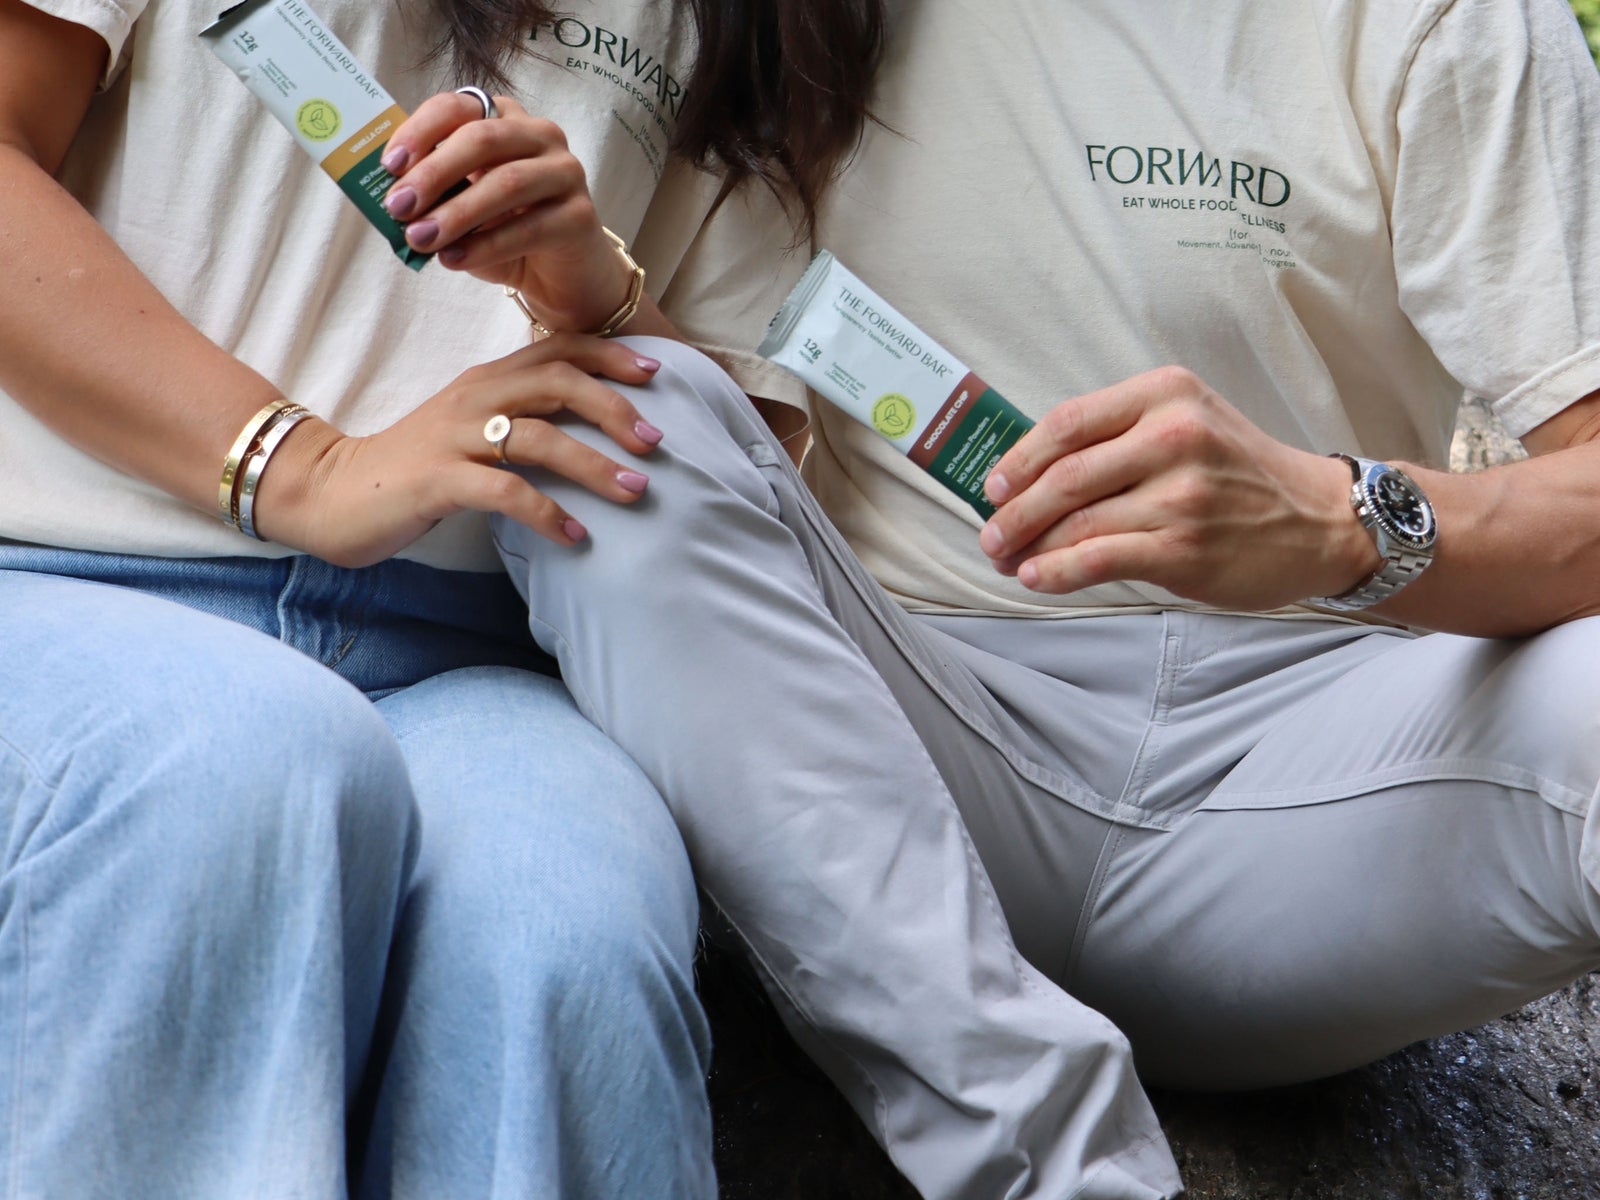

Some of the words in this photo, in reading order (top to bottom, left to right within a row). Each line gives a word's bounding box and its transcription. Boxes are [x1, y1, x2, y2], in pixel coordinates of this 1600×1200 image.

[239, 31, 259, 52] 12g
[304, 20, 358, 74] FORWARD
[322, 56, 338, 73] Better
[566, 57, 590, 71] EAT
[592, 64, 632, 92] WHOLE
[631, 88, 654, 113] FOOD
[359, 175, 371, 186] NO
[370, 187, 381, 197] NO
[1123, 197, 1144, 208] EAT
[1148, 198, 1195, 210] WHOLE
[1240, 213, 1285, 233] ELLNESS
[840, 287, 864, 312] THE
[862, 306, 922, 358] FORWARD
[803, 338, 822, 359] 12g
[867, 330, 886, 346] Tastes
[885, 344, 903, 360] Better
[924, 407, 957, 450] CHOCOLATE
[954, 390, 969, 409] CHIP
[945, 463, 955, 474] NO
[953, 441, 971, 464] Protein
[968, 416, 990, 442] Powders
[957, 472, 968, 484] NO
[965, 449, 985, 473] Refined
[981, 432, 998, 451] Sugar
[969, 481, 980, 493] NO
[977, 466, 992, 483] Seed
[988, 453, 1001, 467] Oils
